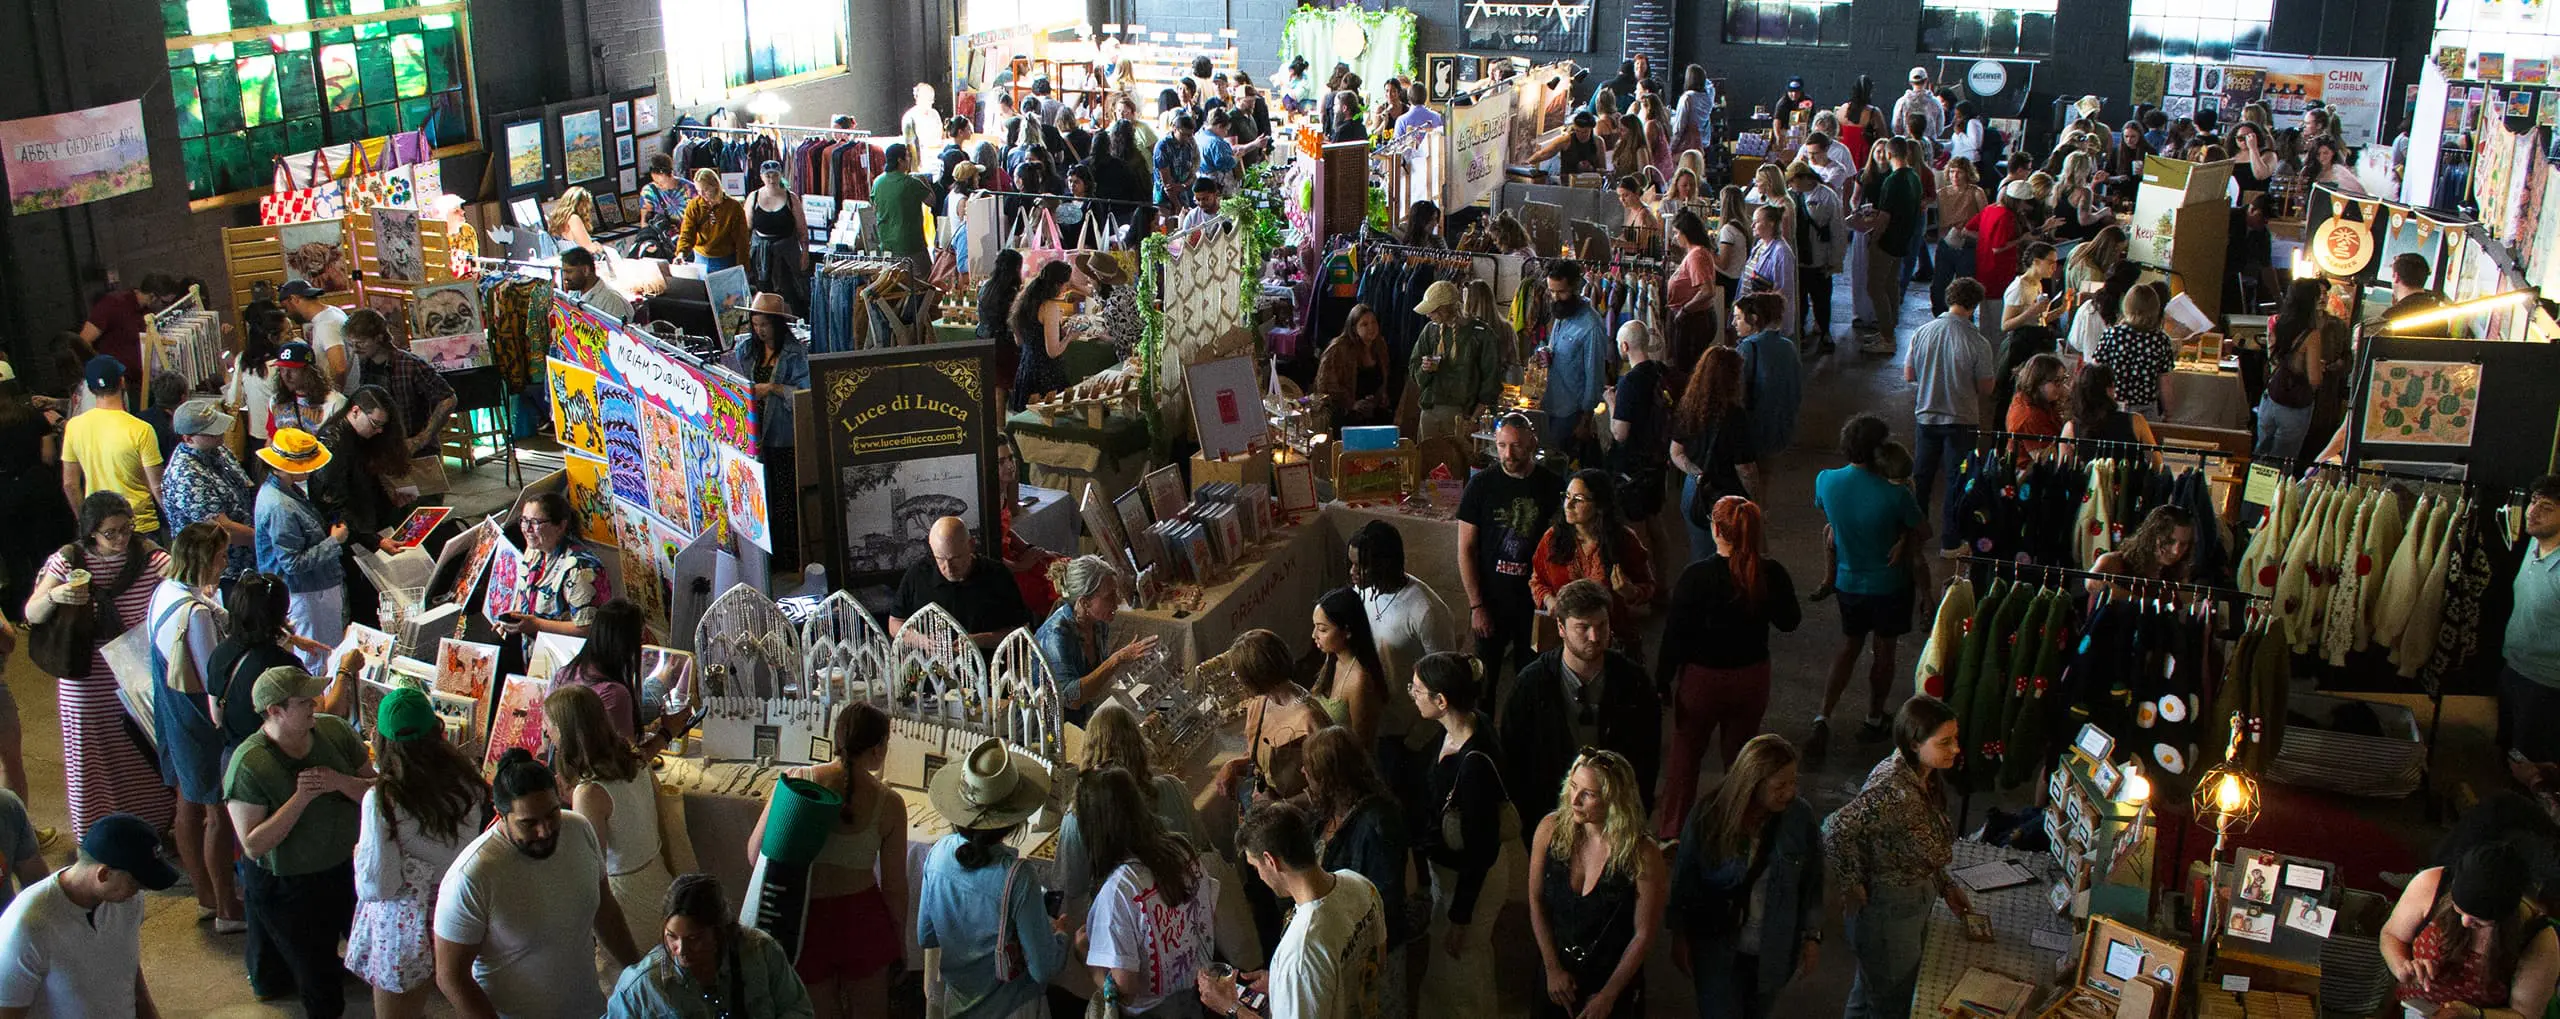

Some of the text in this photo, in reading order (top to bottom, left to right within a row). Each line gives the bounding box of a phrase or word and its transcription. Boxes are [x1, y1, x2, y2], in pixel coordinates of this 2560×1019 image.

[2328, 70, 2363, 82] CHIN
[21, 142, 59, 163] ABBEY
[652, 363, 698, 406] DUBINSKY
[841, 393, 969, 433] Luce di Lucca
[860, 432, 955, 449] www.lucedilucca.com
